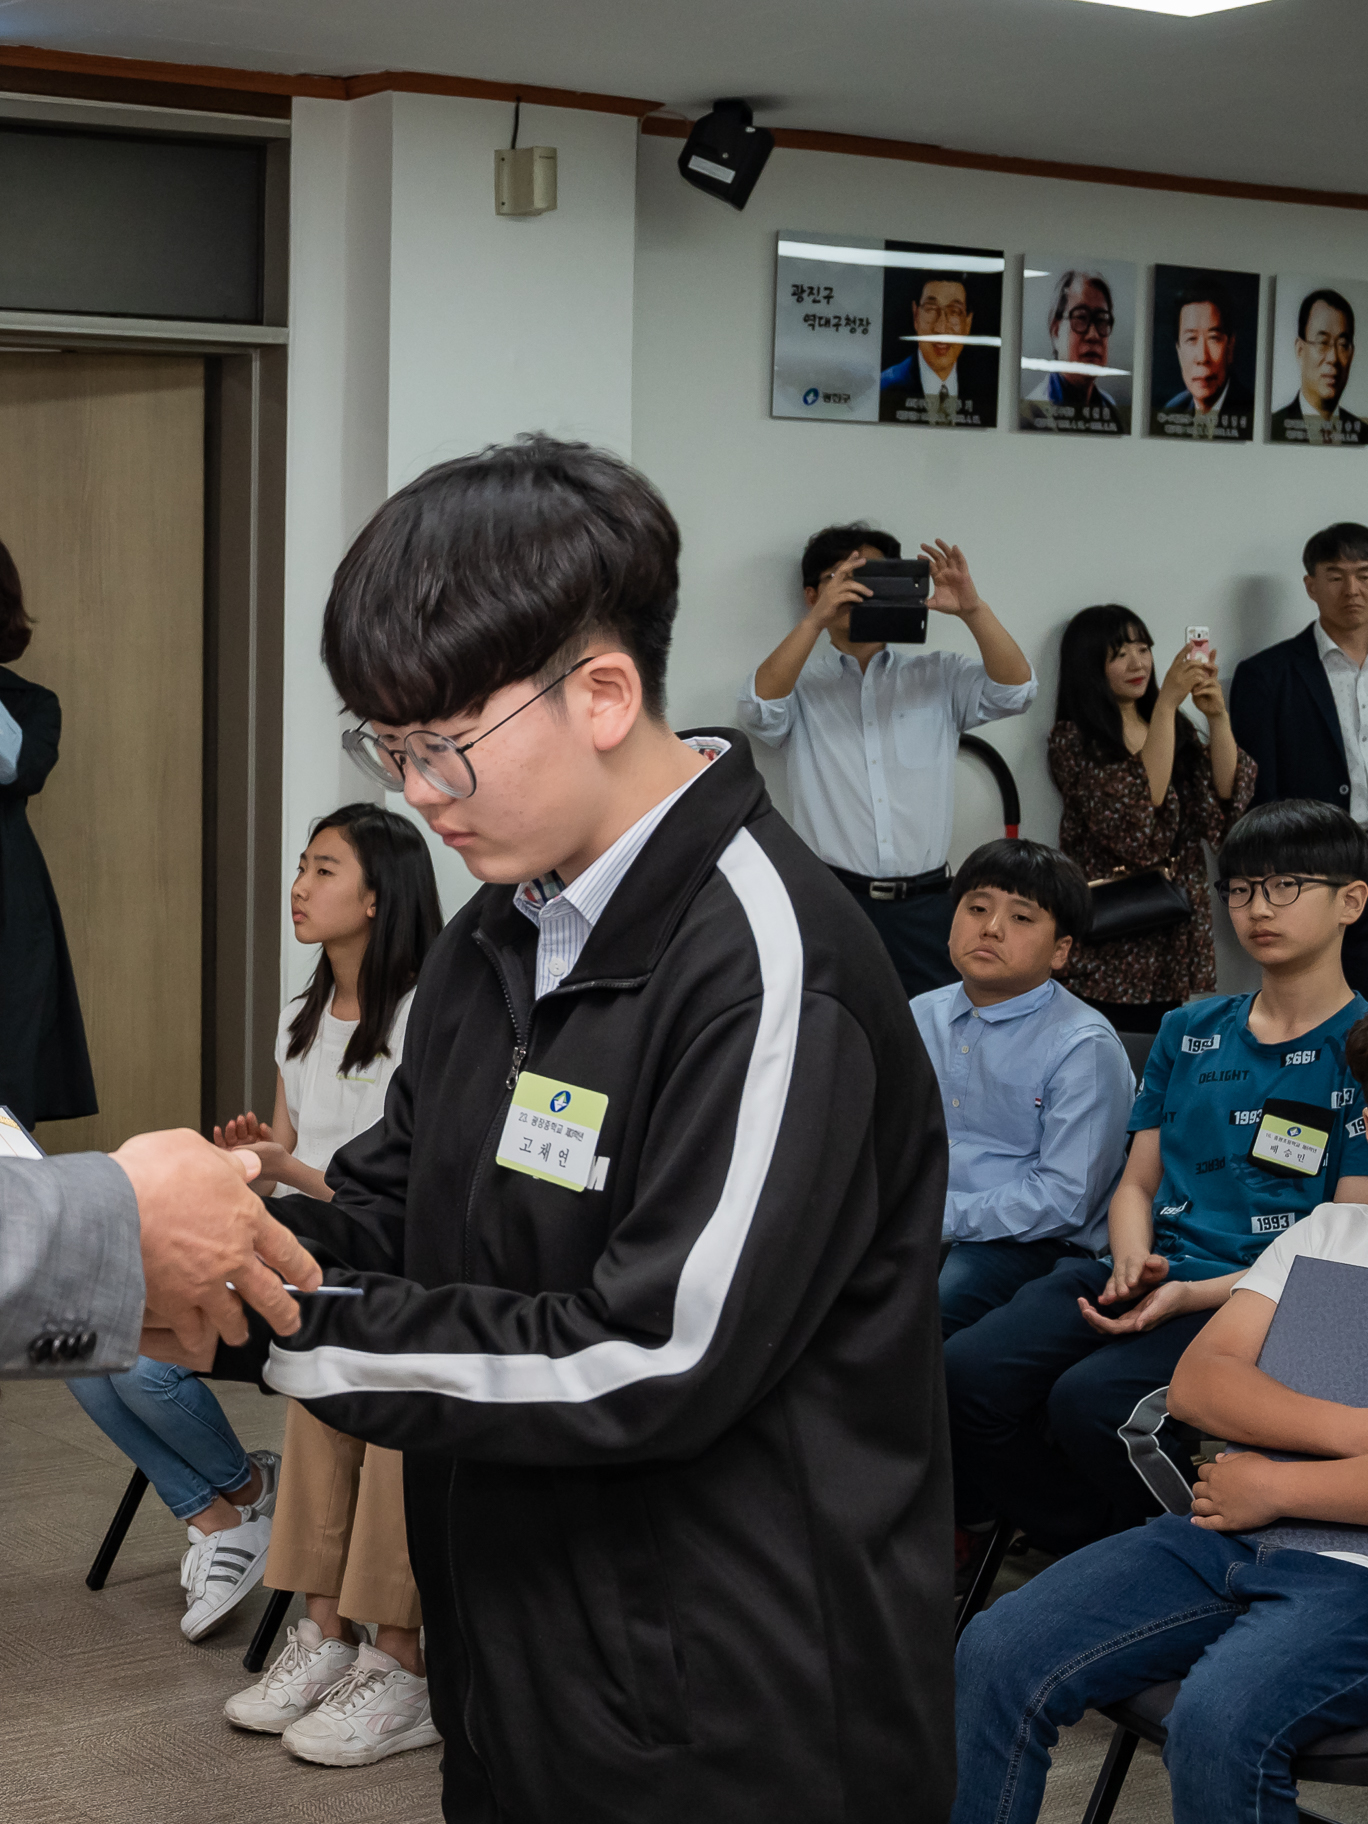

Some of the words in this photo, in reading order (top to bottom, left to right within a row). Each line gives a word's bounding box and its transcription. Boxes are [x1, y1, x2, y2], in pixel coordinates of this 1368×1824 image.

[791, 284, 835, 306] 광진구
[803, 312, 872, 335] 역대구청장
[1198, 1068, 1250, 1085] DELIGHT
[1256, 1214, 1290, 1232] 1993
